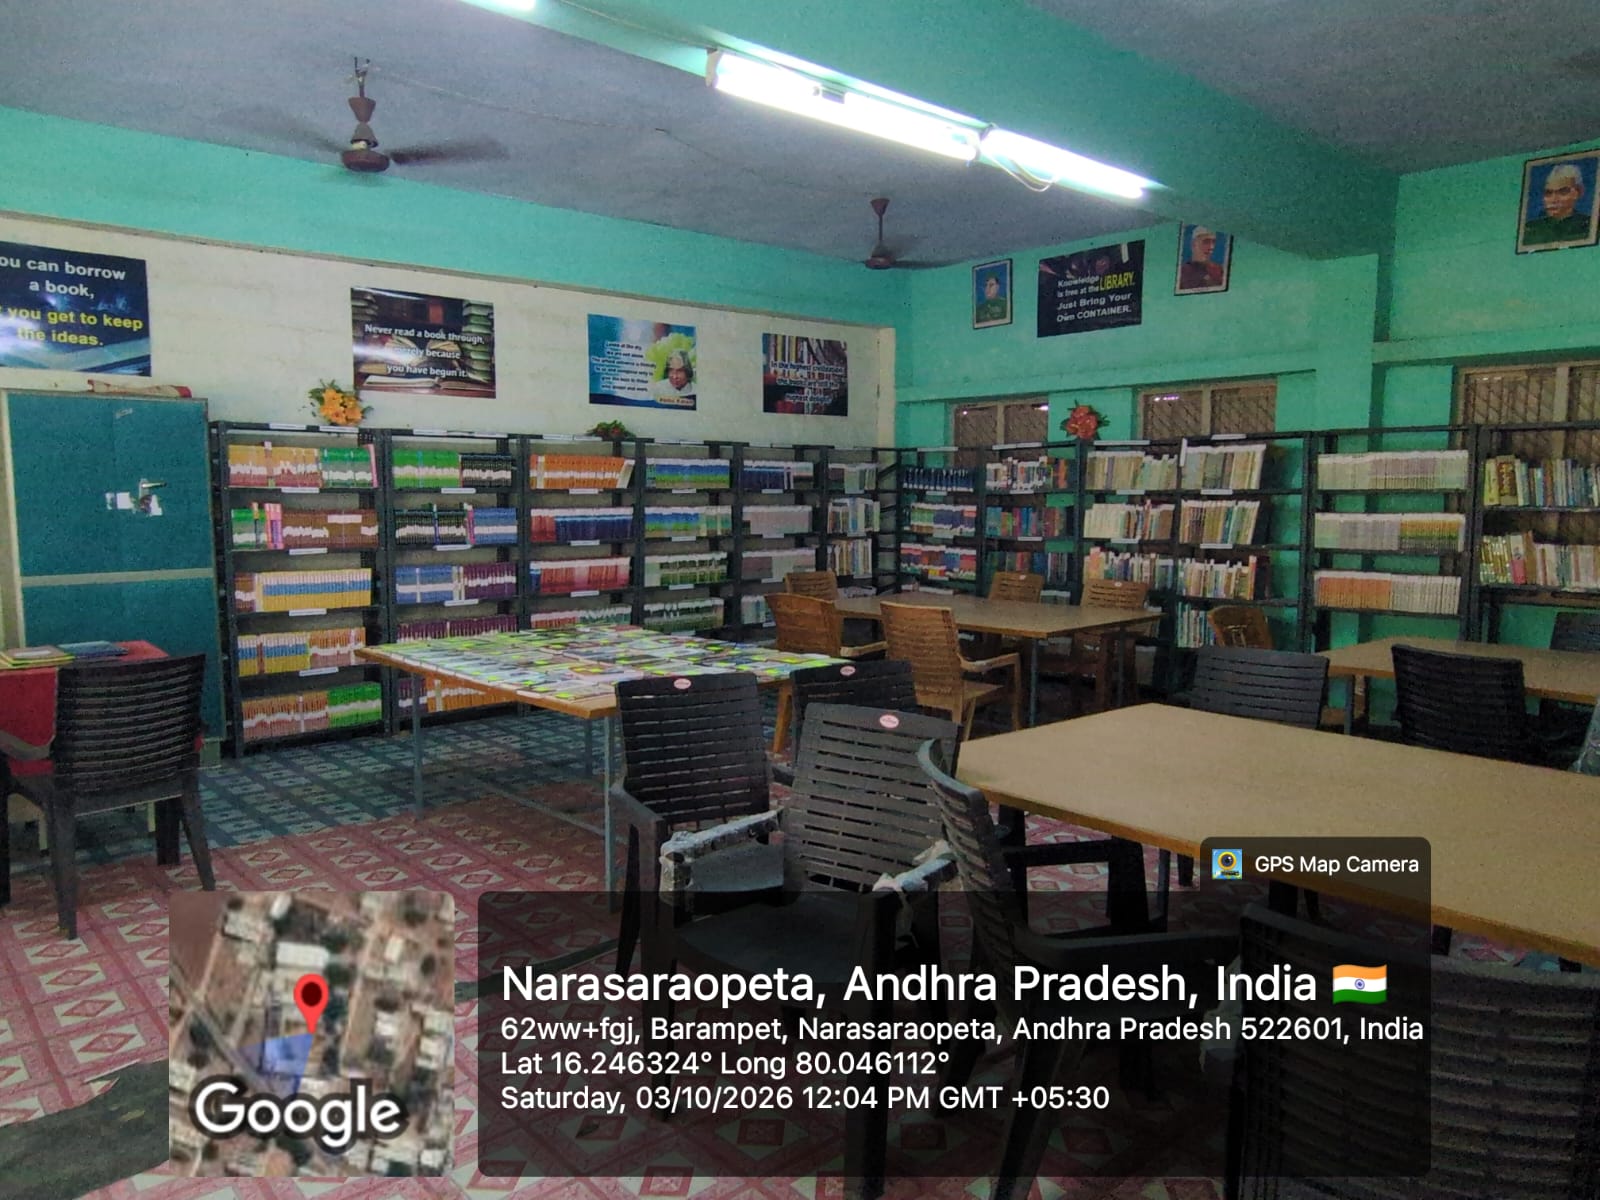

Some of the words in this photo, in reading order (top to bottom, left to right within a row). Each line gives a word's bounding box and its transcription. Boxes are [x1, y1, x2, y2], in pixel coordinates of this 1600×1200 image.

[26, 259, 59, 273] can
[65, 261, 126, 280] borrow
[29, 281, 39, 291] a
[45, 280, 94, 299] book,
[1057, 301, 1077, 311] Just
[1080, 297, 1106, 306] Bring
[1109, 293, 1132, 302] Your
[8, 308, 41, 320] you
[47, 311, 76, 324] get
[80, 313, 98, 325] to
[103, 314, 143, 331] keep
[17, 328, 46, 341] the
[51, 330, 104, 346] ideas.
[364, 324, 393, 334] Never
[394, 328, 415, 337] read
[424, 329, 446, 340] book
[426, 350, 460, 360] because
[387, 365, 405, 374] you
[406, 365, 428, 374] have
[429, 368, 457, 378] begun
